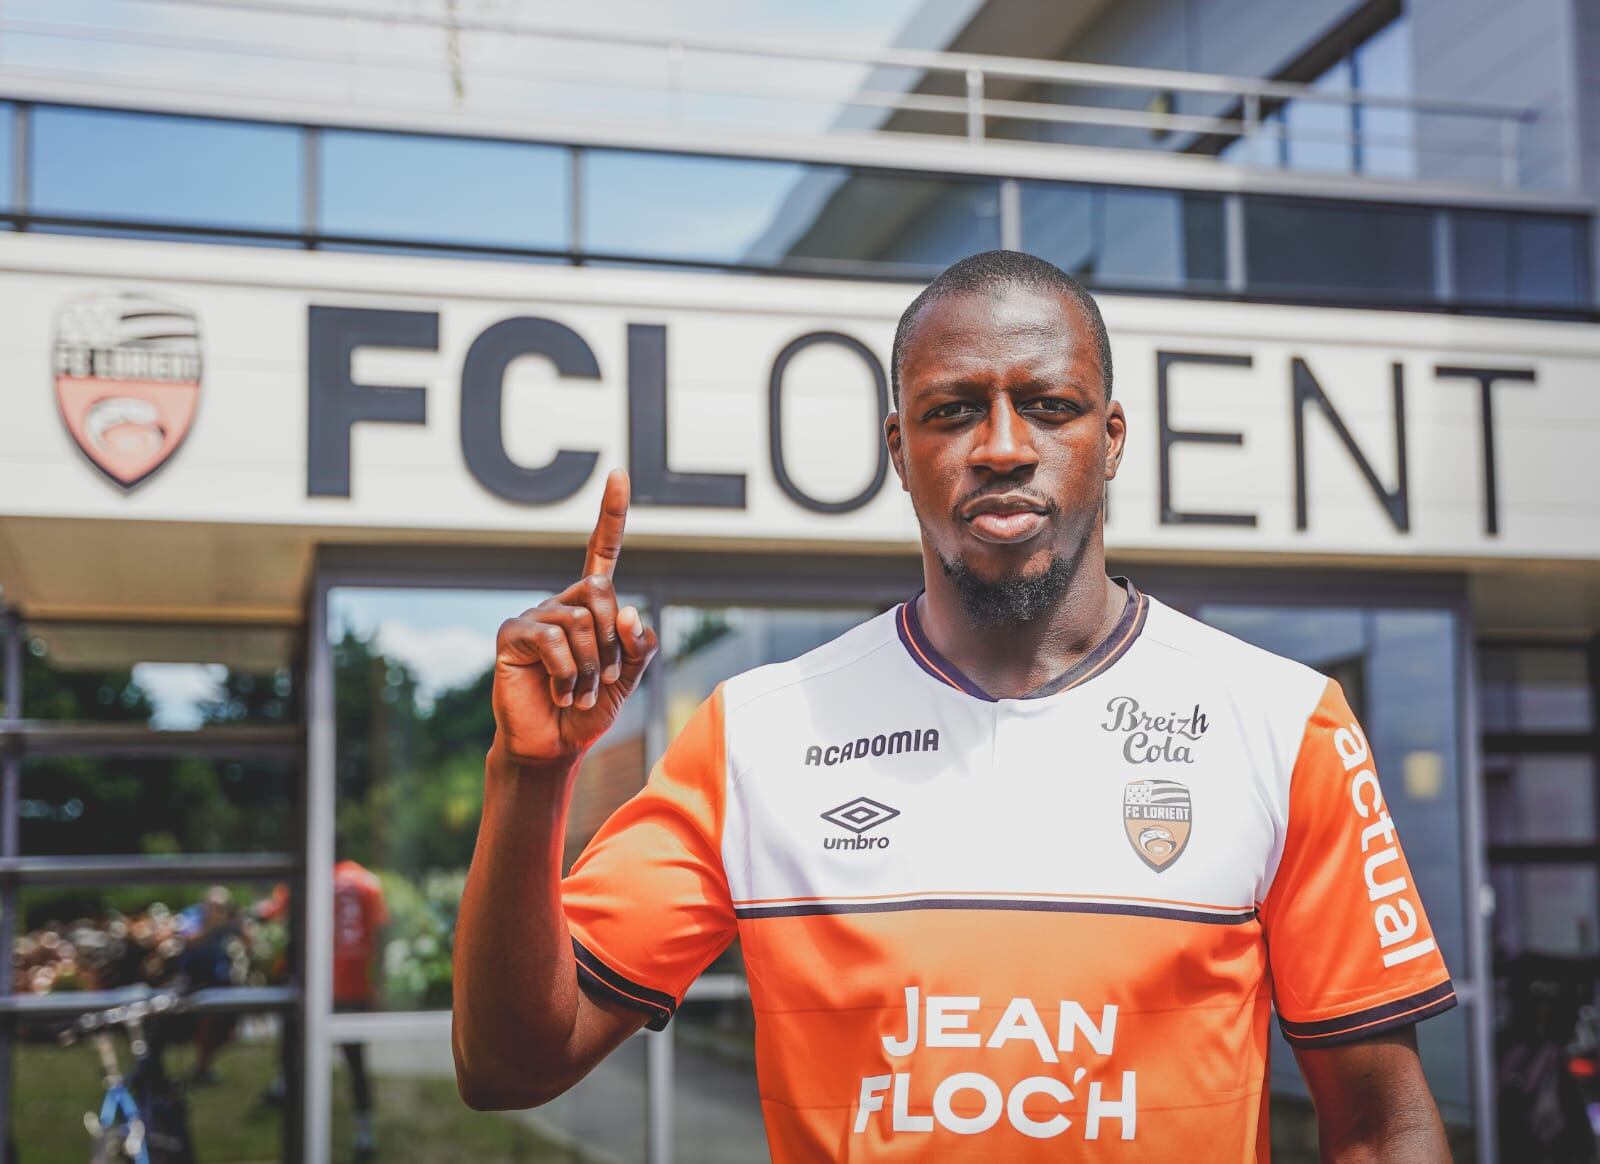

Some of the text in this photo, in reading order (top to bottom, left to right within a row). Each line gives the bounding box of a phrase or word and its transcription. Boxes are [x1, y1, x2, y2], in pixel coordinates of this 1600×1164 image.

[1101, 696, 1209, 741] Breizh
[804, 728, 939, 767] ACADOMIA
[1123, 732, 1194, 764] Cola
[1125, 805, 1190, 821] FC LORIENT
[823, 834, 890, 851] umbro
[1333, 722, 1436, 968] actual
[881, 986, 1119, 1063] JEAN
[853, 1067, 1137, 1140] FLOC'H
